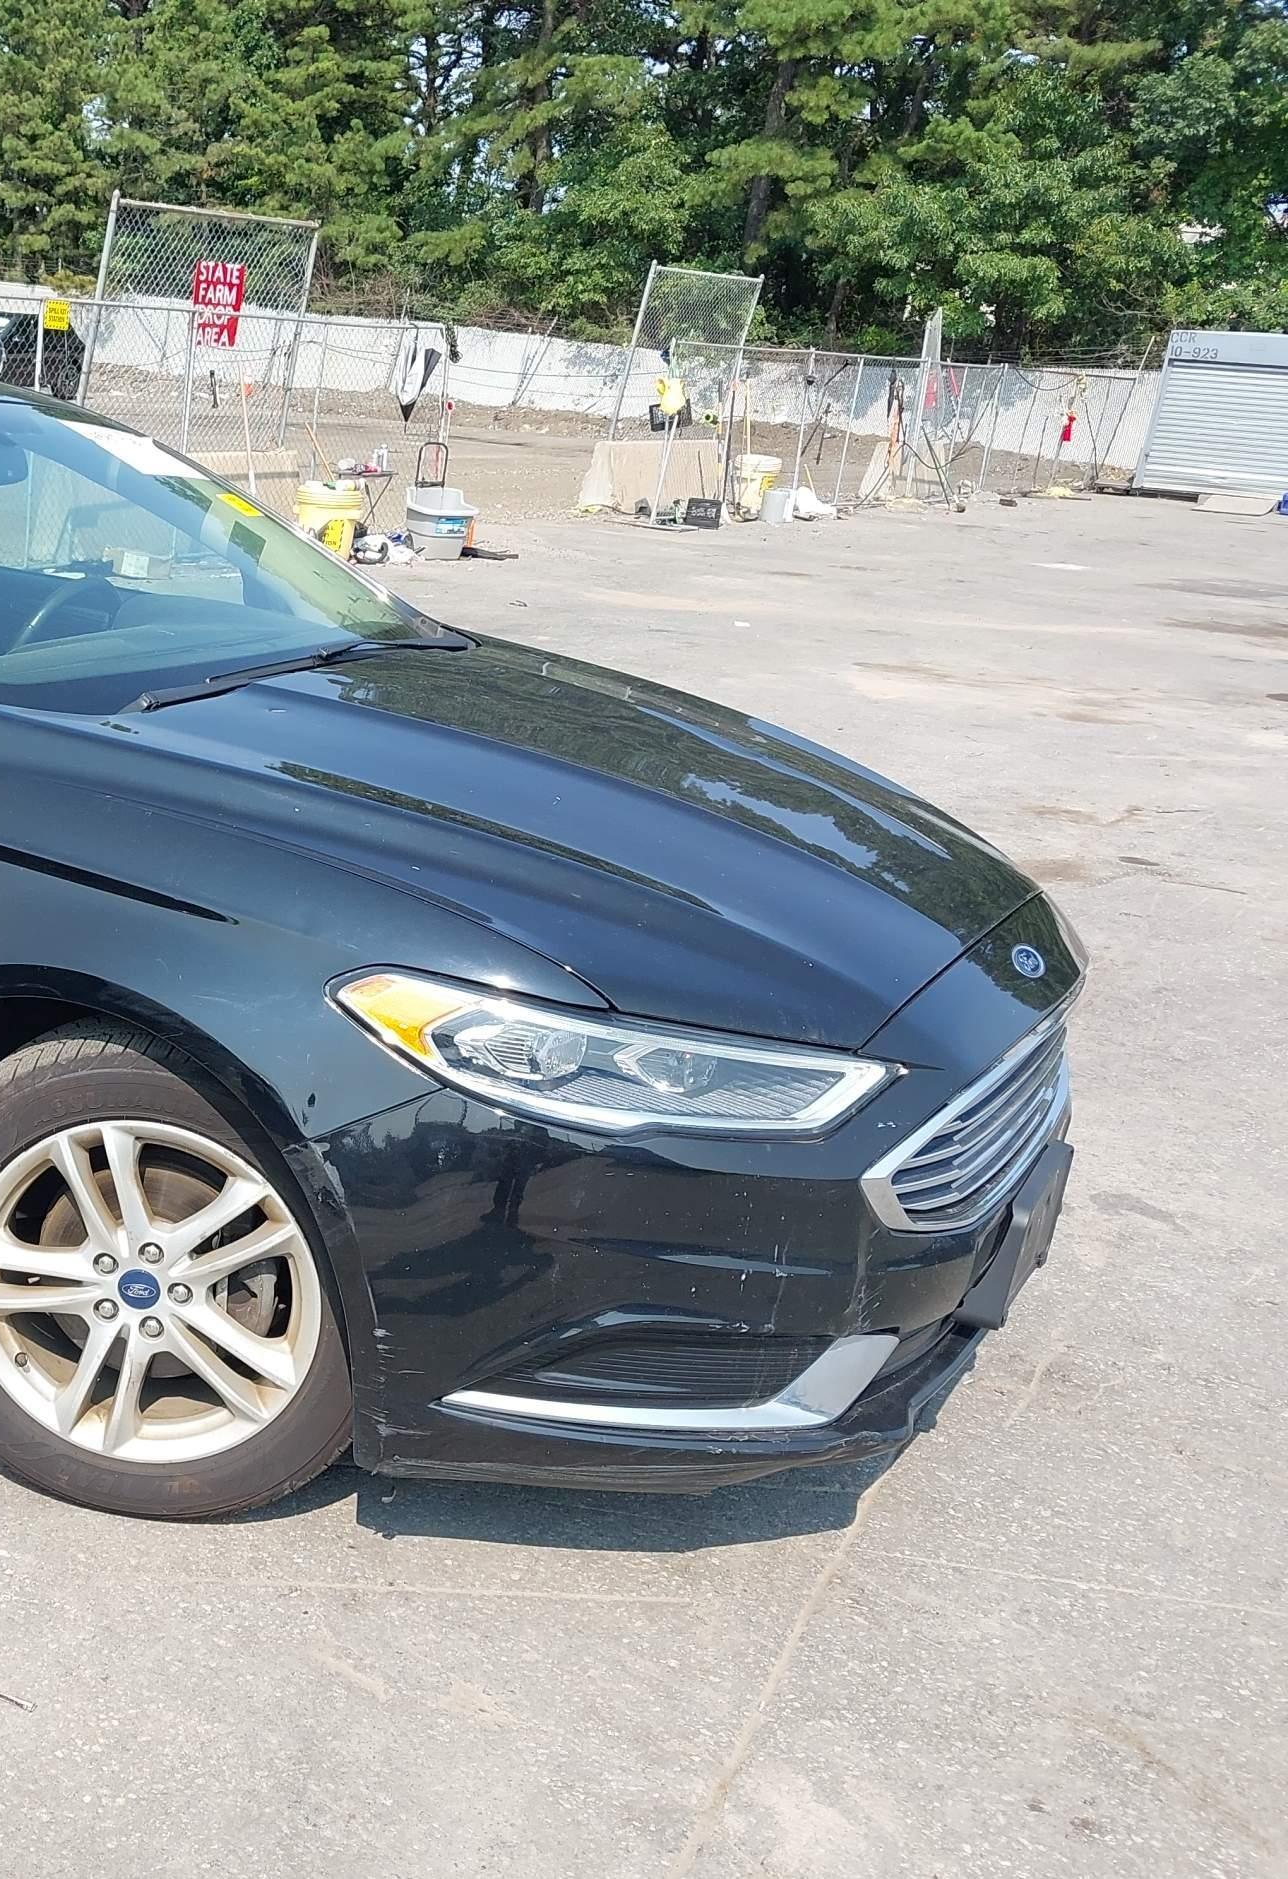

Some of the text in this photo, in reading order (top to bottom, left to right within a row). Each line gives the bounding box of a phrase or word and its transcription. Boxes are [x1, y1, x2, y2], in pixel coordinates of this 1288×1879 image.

[199, 261, 242, 284] STATE
[198, 282, 237, 305] FARM
[194, 304, 233, 325] DROP
[196, 326, 230, 347] AREA
[1170, 332, 1197, 343] CCR
[1170, 345, 1219, 359] 10-923
[126, 1285, 151, 1297] Ford
